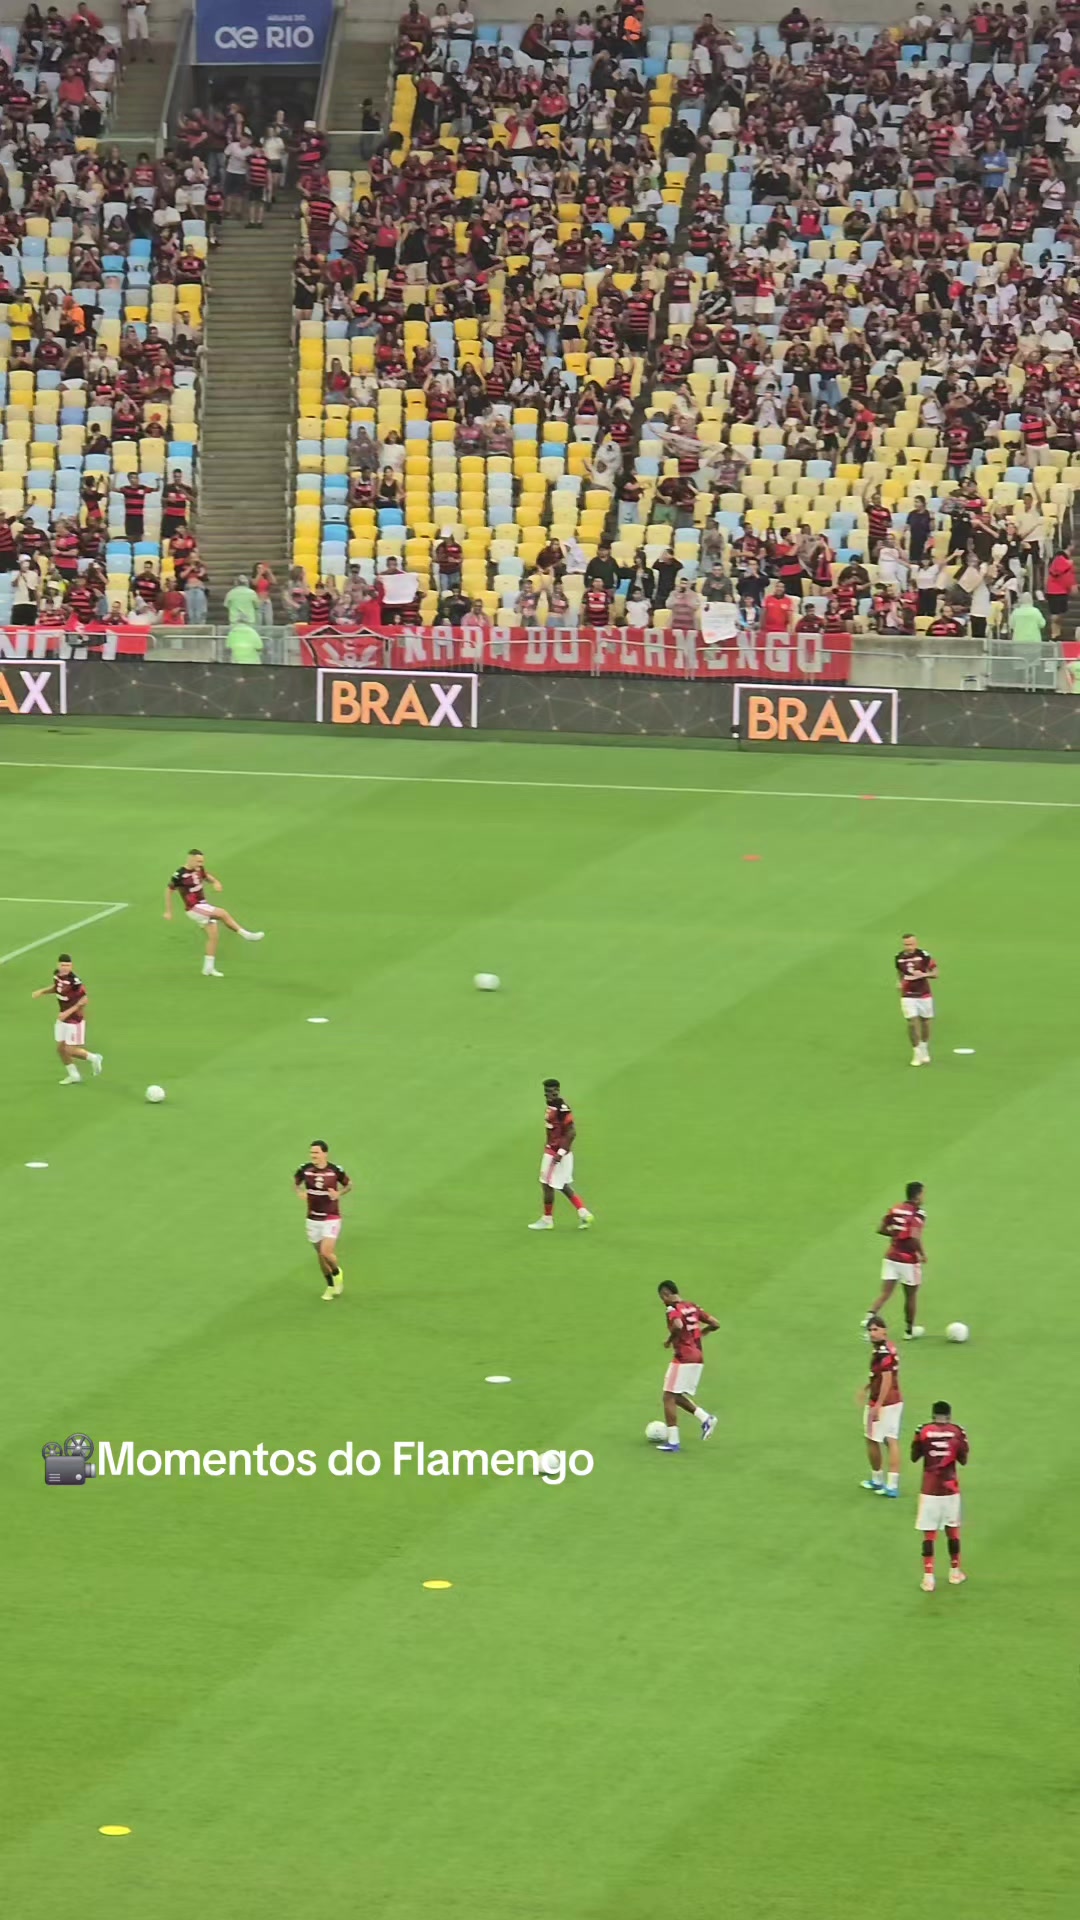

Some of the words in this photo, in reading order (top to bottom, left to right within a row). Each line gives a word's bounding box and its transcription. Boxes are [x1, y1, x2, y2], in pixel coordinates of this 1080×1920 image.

[266, 25, 314, 48] RIO
[402, 625, 511, 664] NADA
[525, 626, 579, 665] DO
[594, 626, 824, 673] FLAMENGO
[331, 680, 464, 728] BRAX
[747, 696, 883, 744] BRAX
